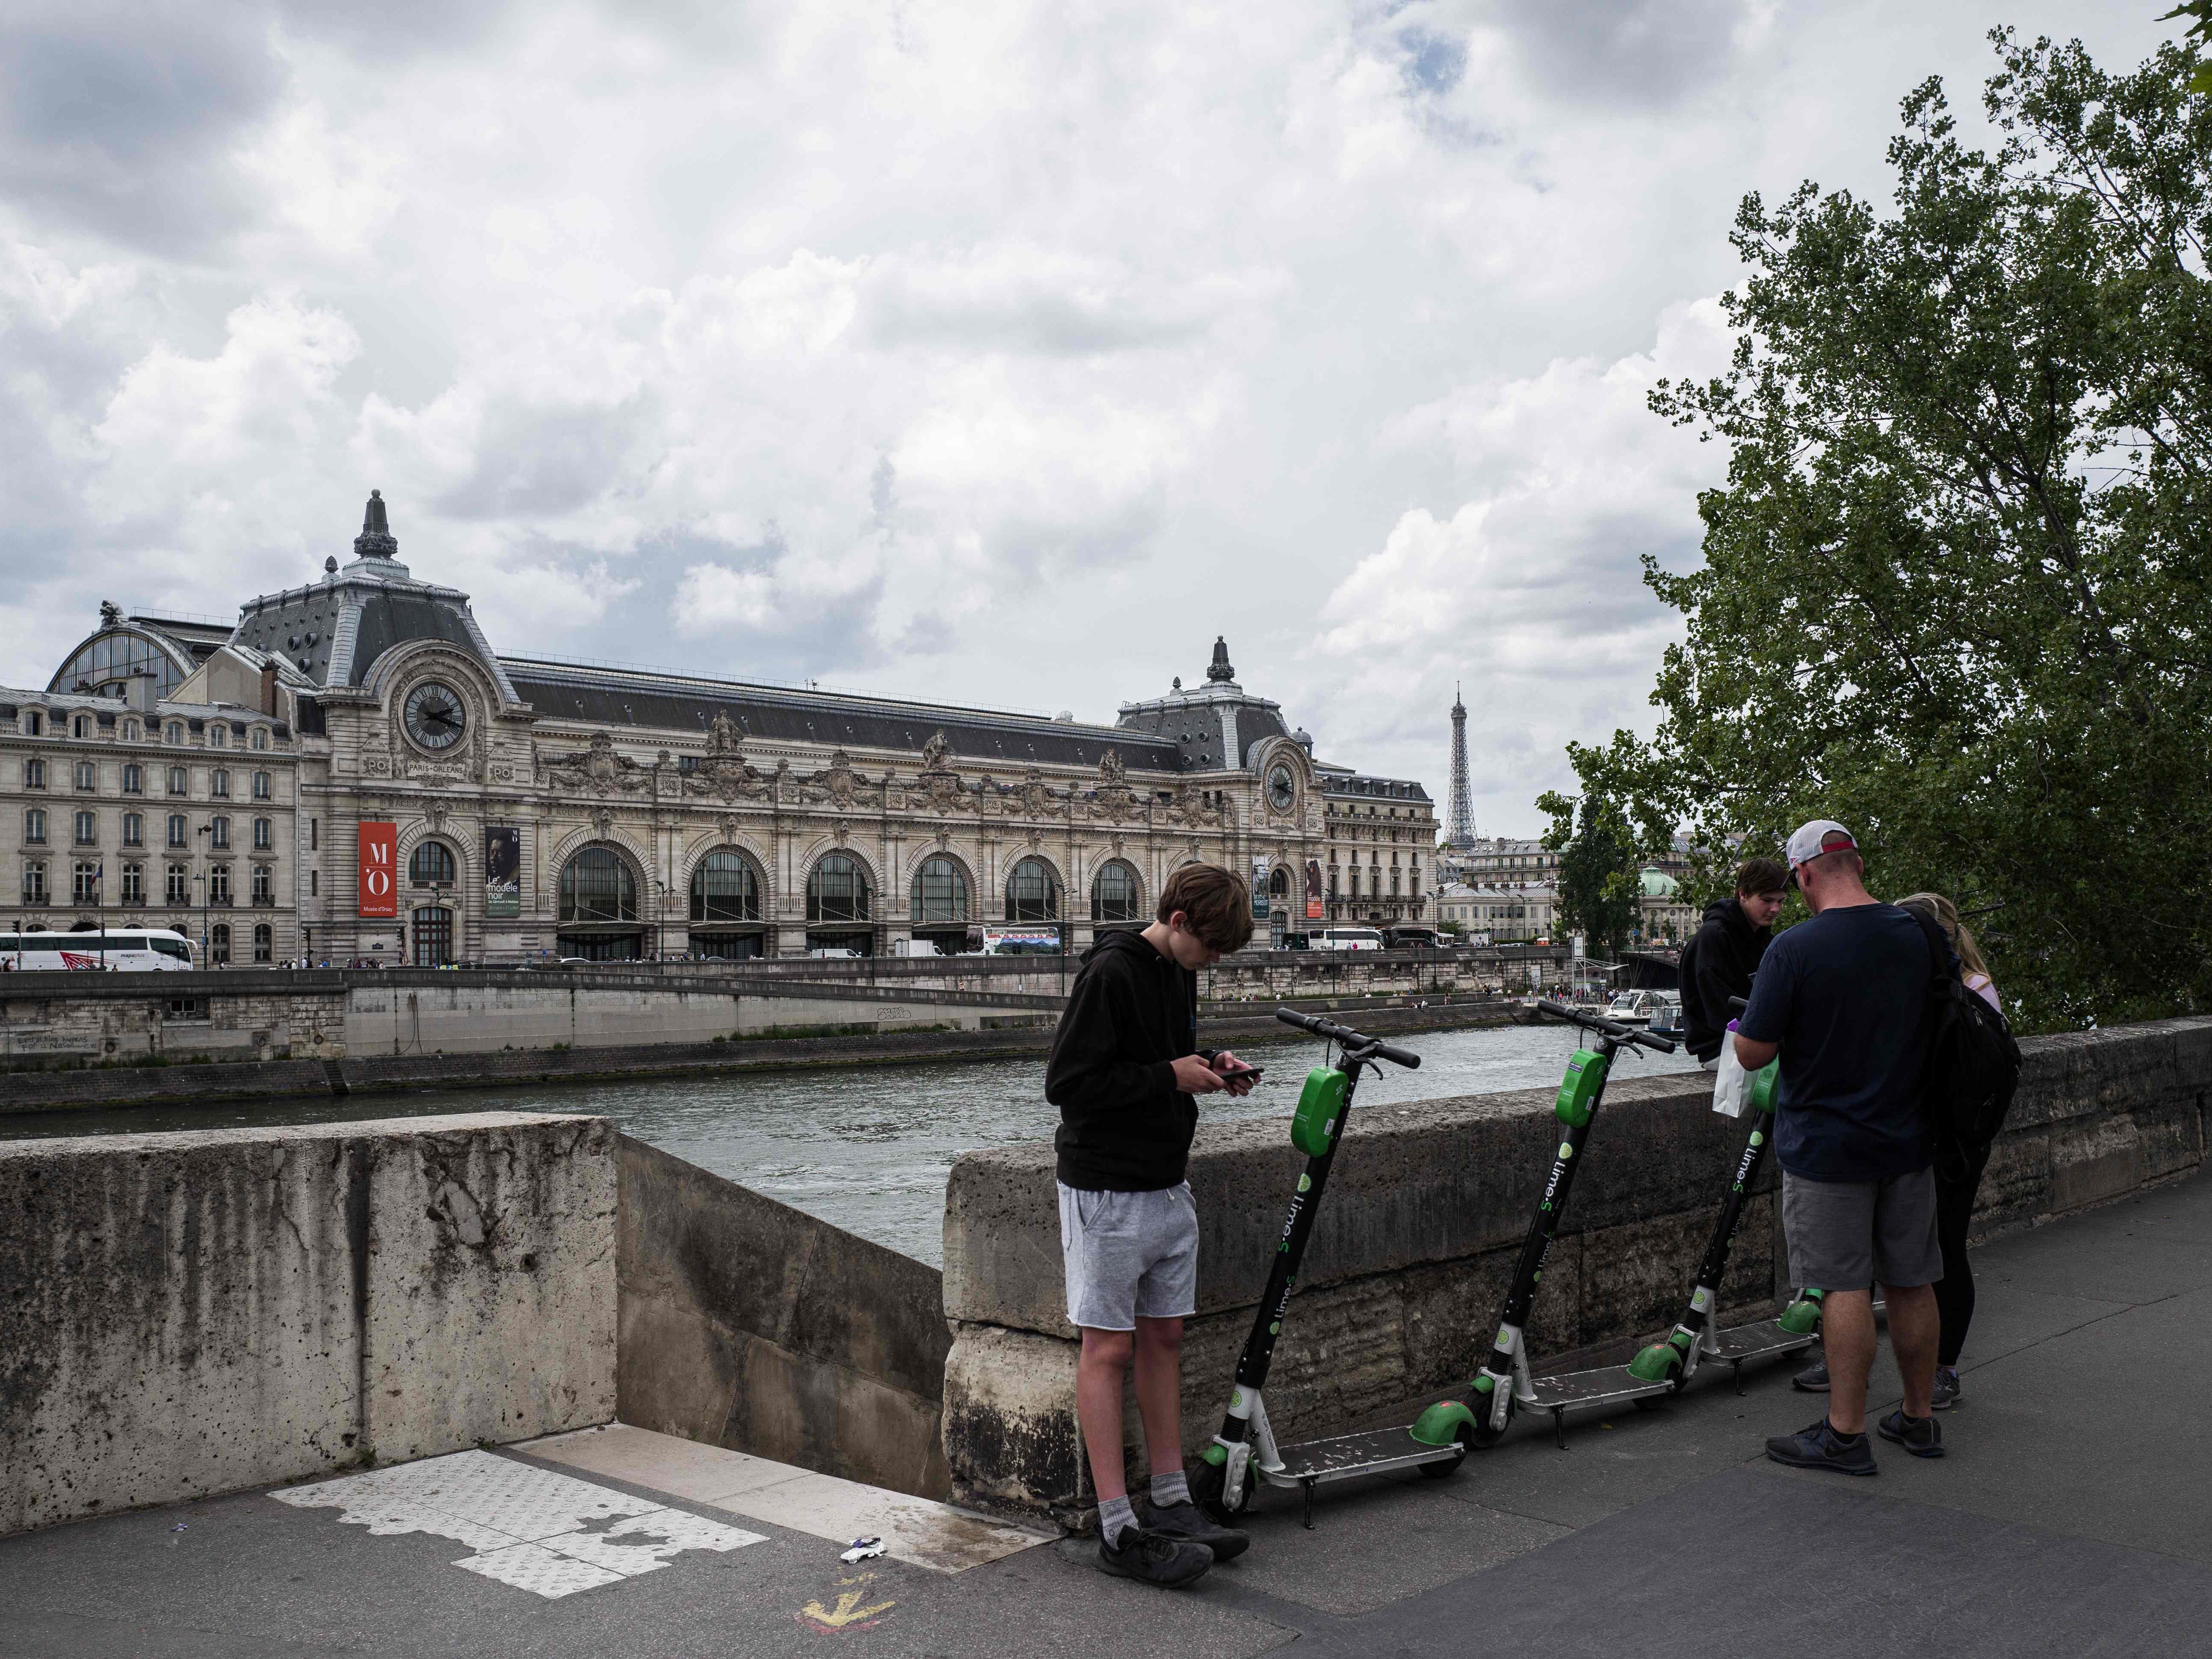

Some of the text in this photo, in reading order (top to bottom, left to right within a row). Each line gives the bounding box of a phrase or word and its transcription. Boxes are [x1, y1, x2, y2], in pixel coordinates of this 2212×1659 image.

[369, 760, 386, 771] PO
[409, 764, 463, 774] PARIS-ORLEANS
[494, 768, 510, 778] PO
[368, 843, 389, 864] M
[488, 875, 498, 884] Le
